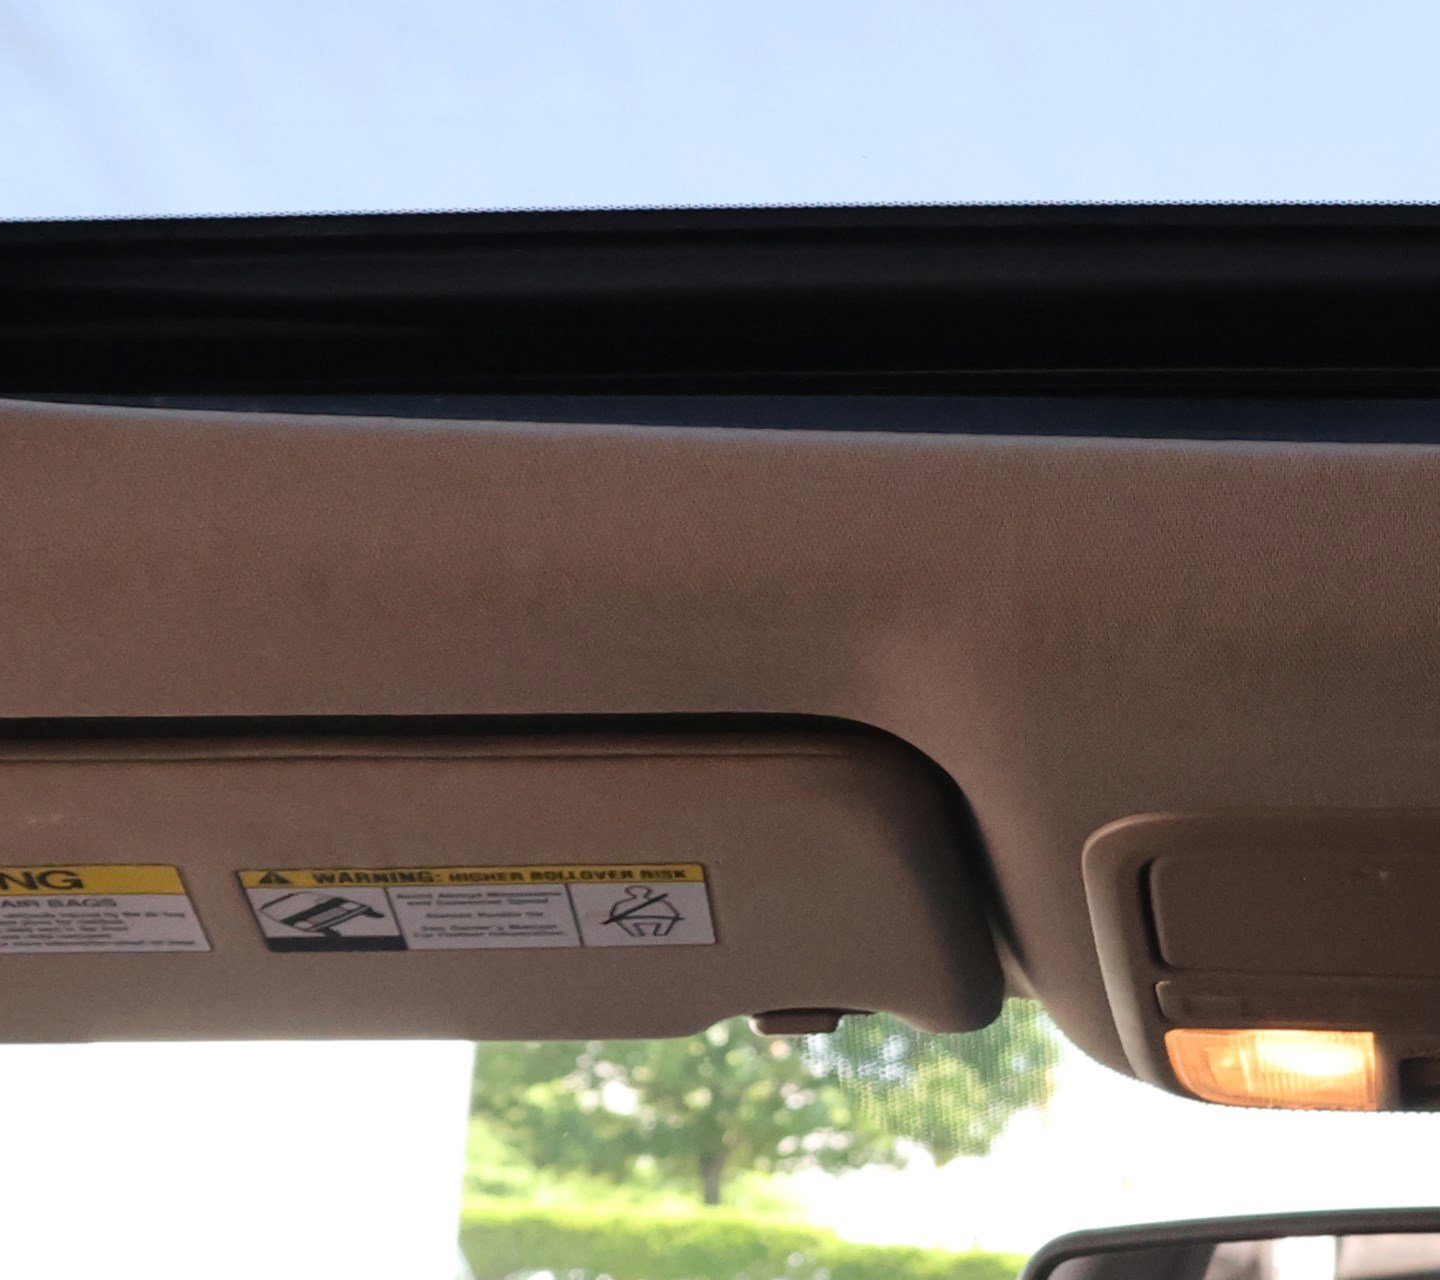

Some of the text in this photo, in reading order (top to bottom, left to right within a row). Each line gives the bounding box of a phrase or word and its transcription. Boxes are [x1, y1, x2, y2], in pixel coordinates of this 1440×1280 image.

[530, 869, 634, 881] ROLLOVER
[639, 868, 687, 880] RISK
[0, 898, 41, 909] AIR
[49, 897, 117, 908] BAGS
